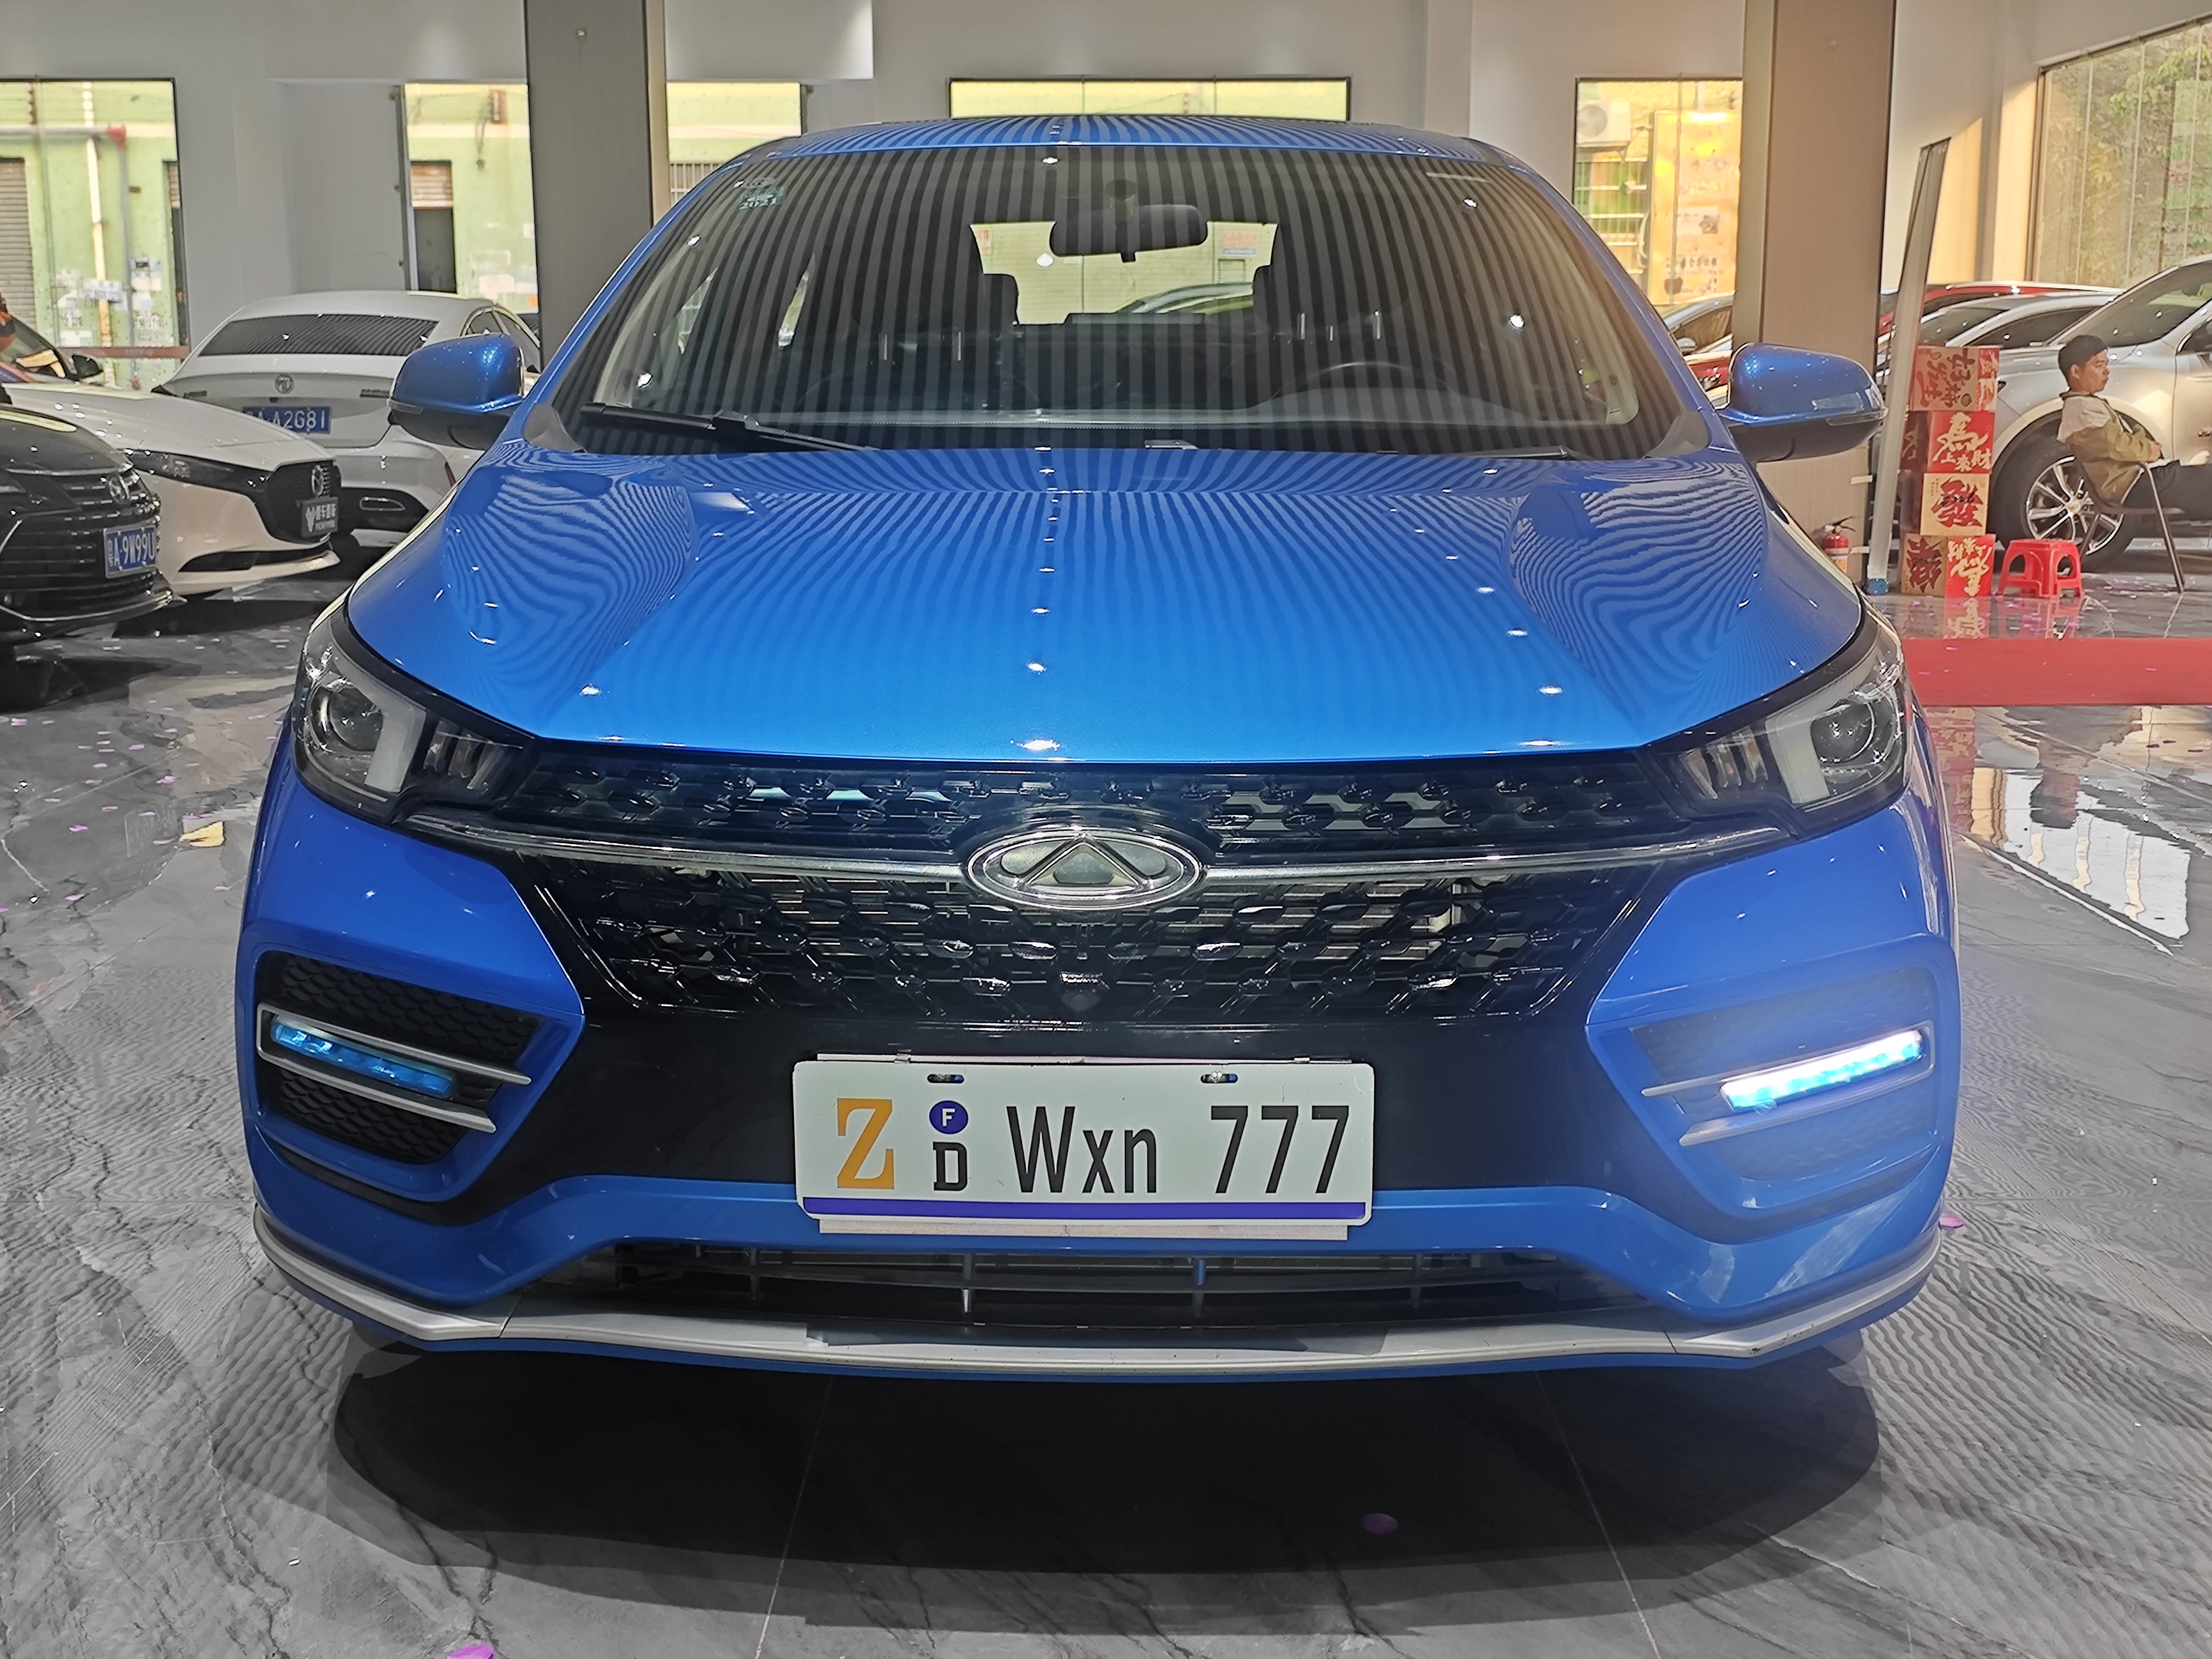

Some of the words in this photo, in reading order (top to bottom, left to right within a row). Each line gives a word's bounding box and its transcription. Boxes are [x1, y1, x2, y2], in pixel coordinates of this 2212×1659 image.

[247, 410, 325, 429] ·A2G81
[942, 1108, 955, 1127] F
[837, 1097, 894, 1190] Z
[933, 1141, 968, 1191] D
[1006, 1105, 1157, 1193] Wxn
[1210, 1104, 1350, 1193] 777
